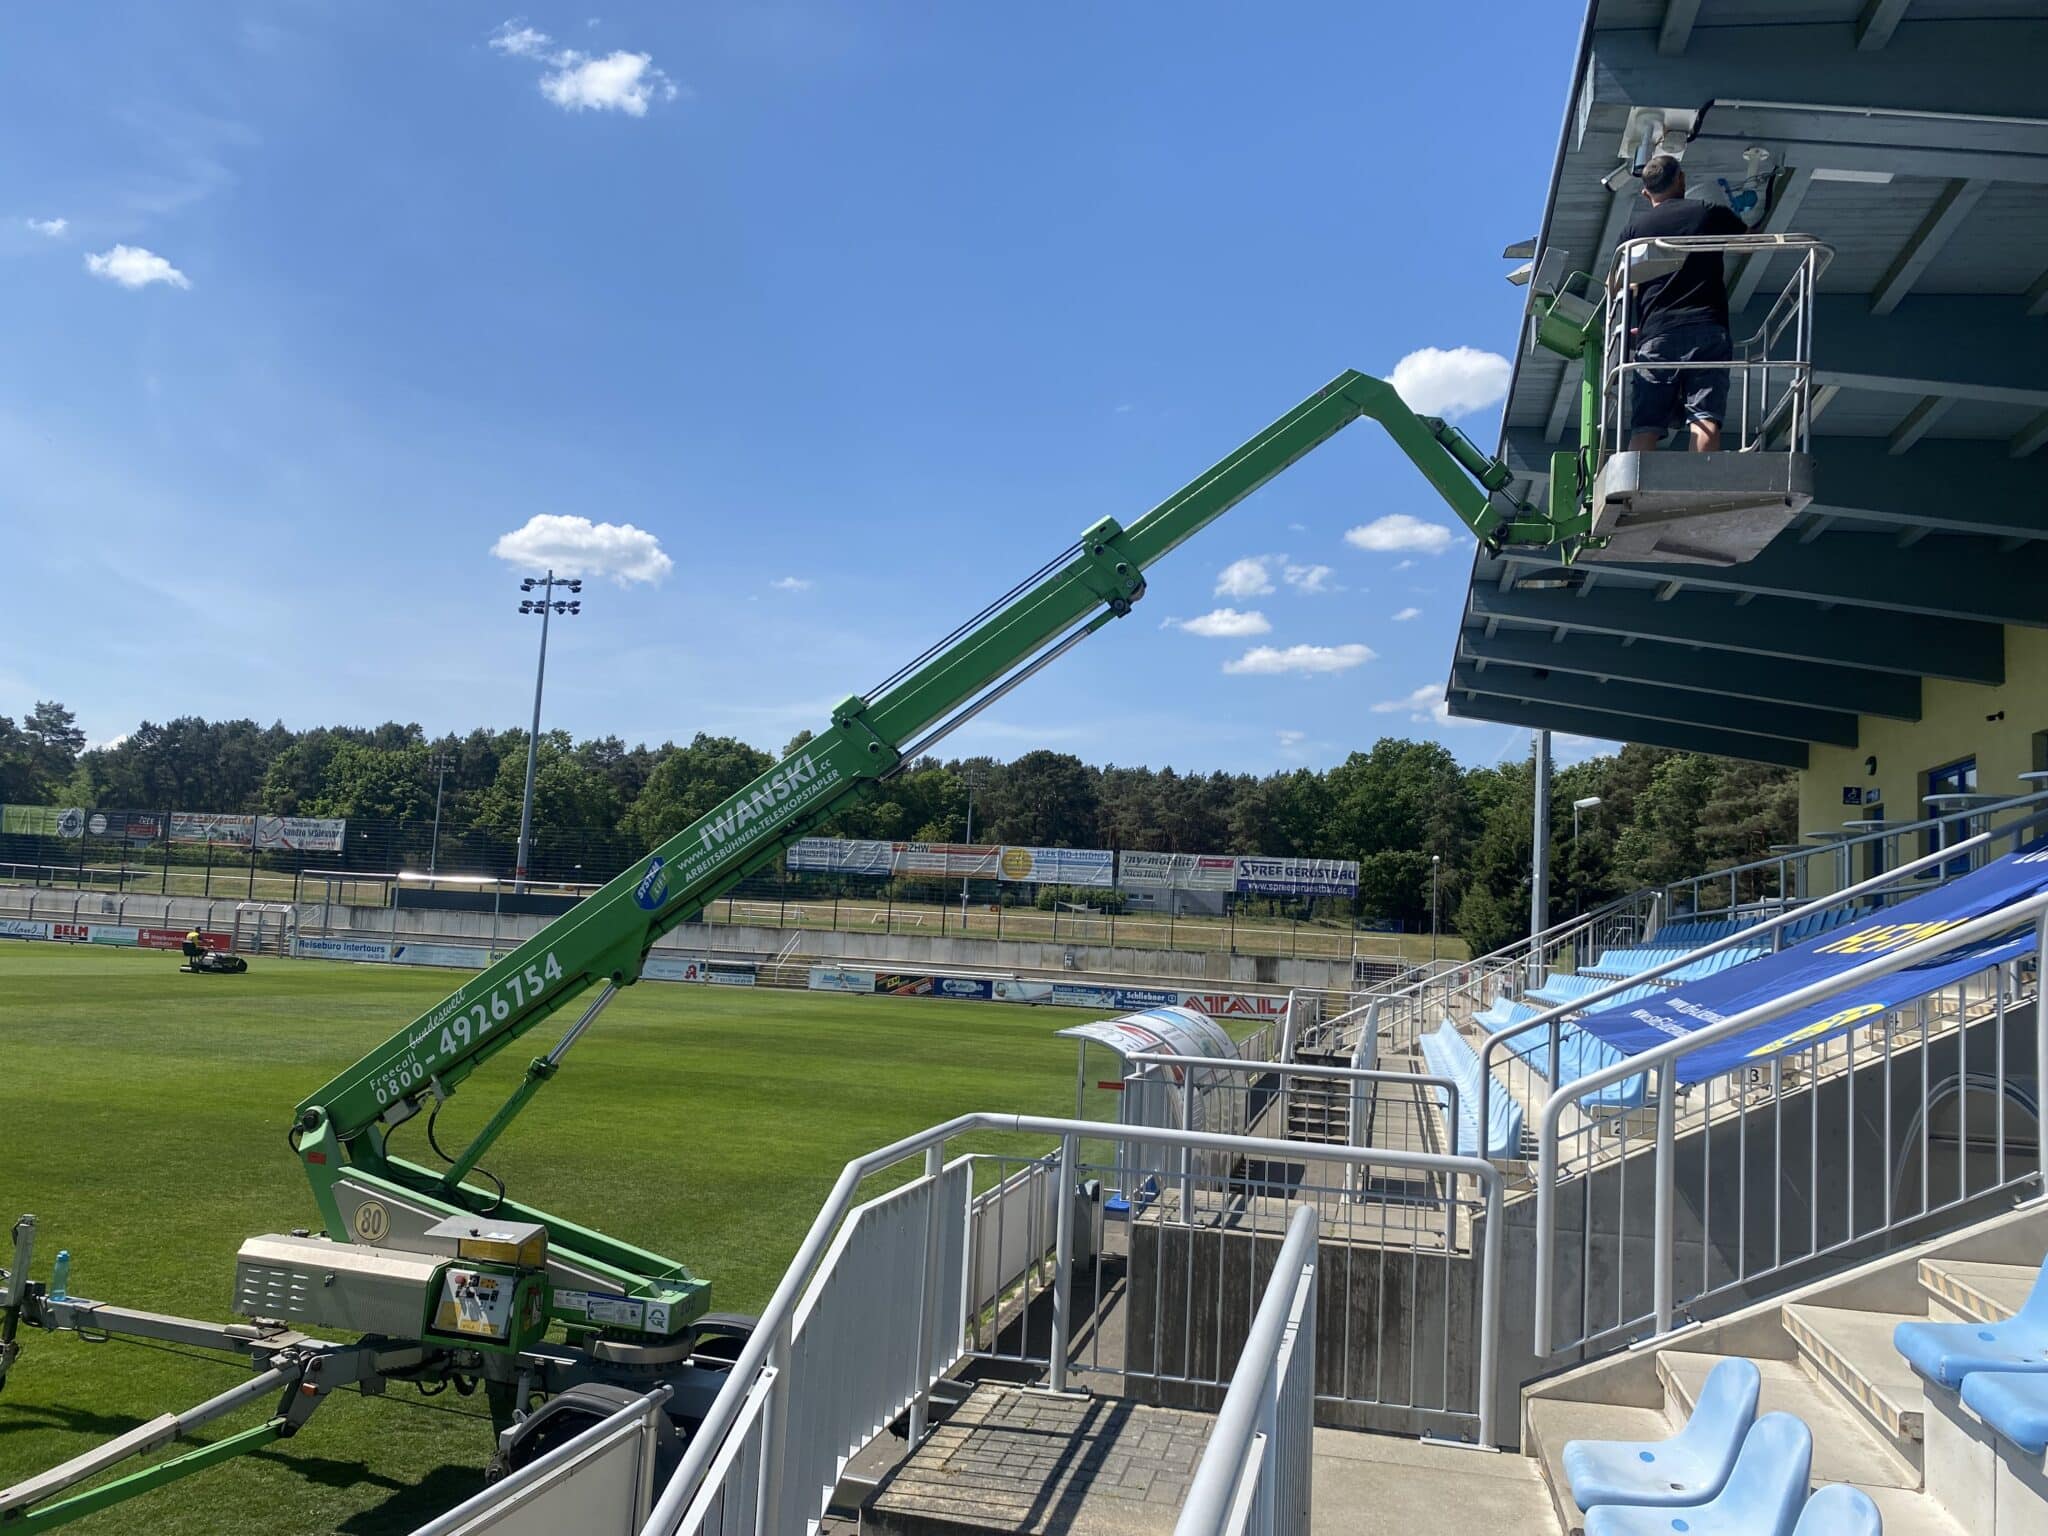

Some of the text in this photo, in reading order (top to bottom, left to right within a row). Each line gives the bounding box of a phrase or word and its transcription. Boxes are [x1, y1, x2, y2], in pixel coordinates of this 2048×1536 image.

[685, 769, 840, 883] ARBEITSBÜHNEN-TELESKOPSTAPLER
[908, 843, 929, 853] ZHW
[54, 924, 88, 936] BELM
[344, 942, 385, 953] Intertours
[408, 988, 466, 1050] bundesweit
[369, 1051, 417, 1091] Freecall
[1750, 1069, 1759, 1082] 3
[360, 1207, 382, 1235] 80
